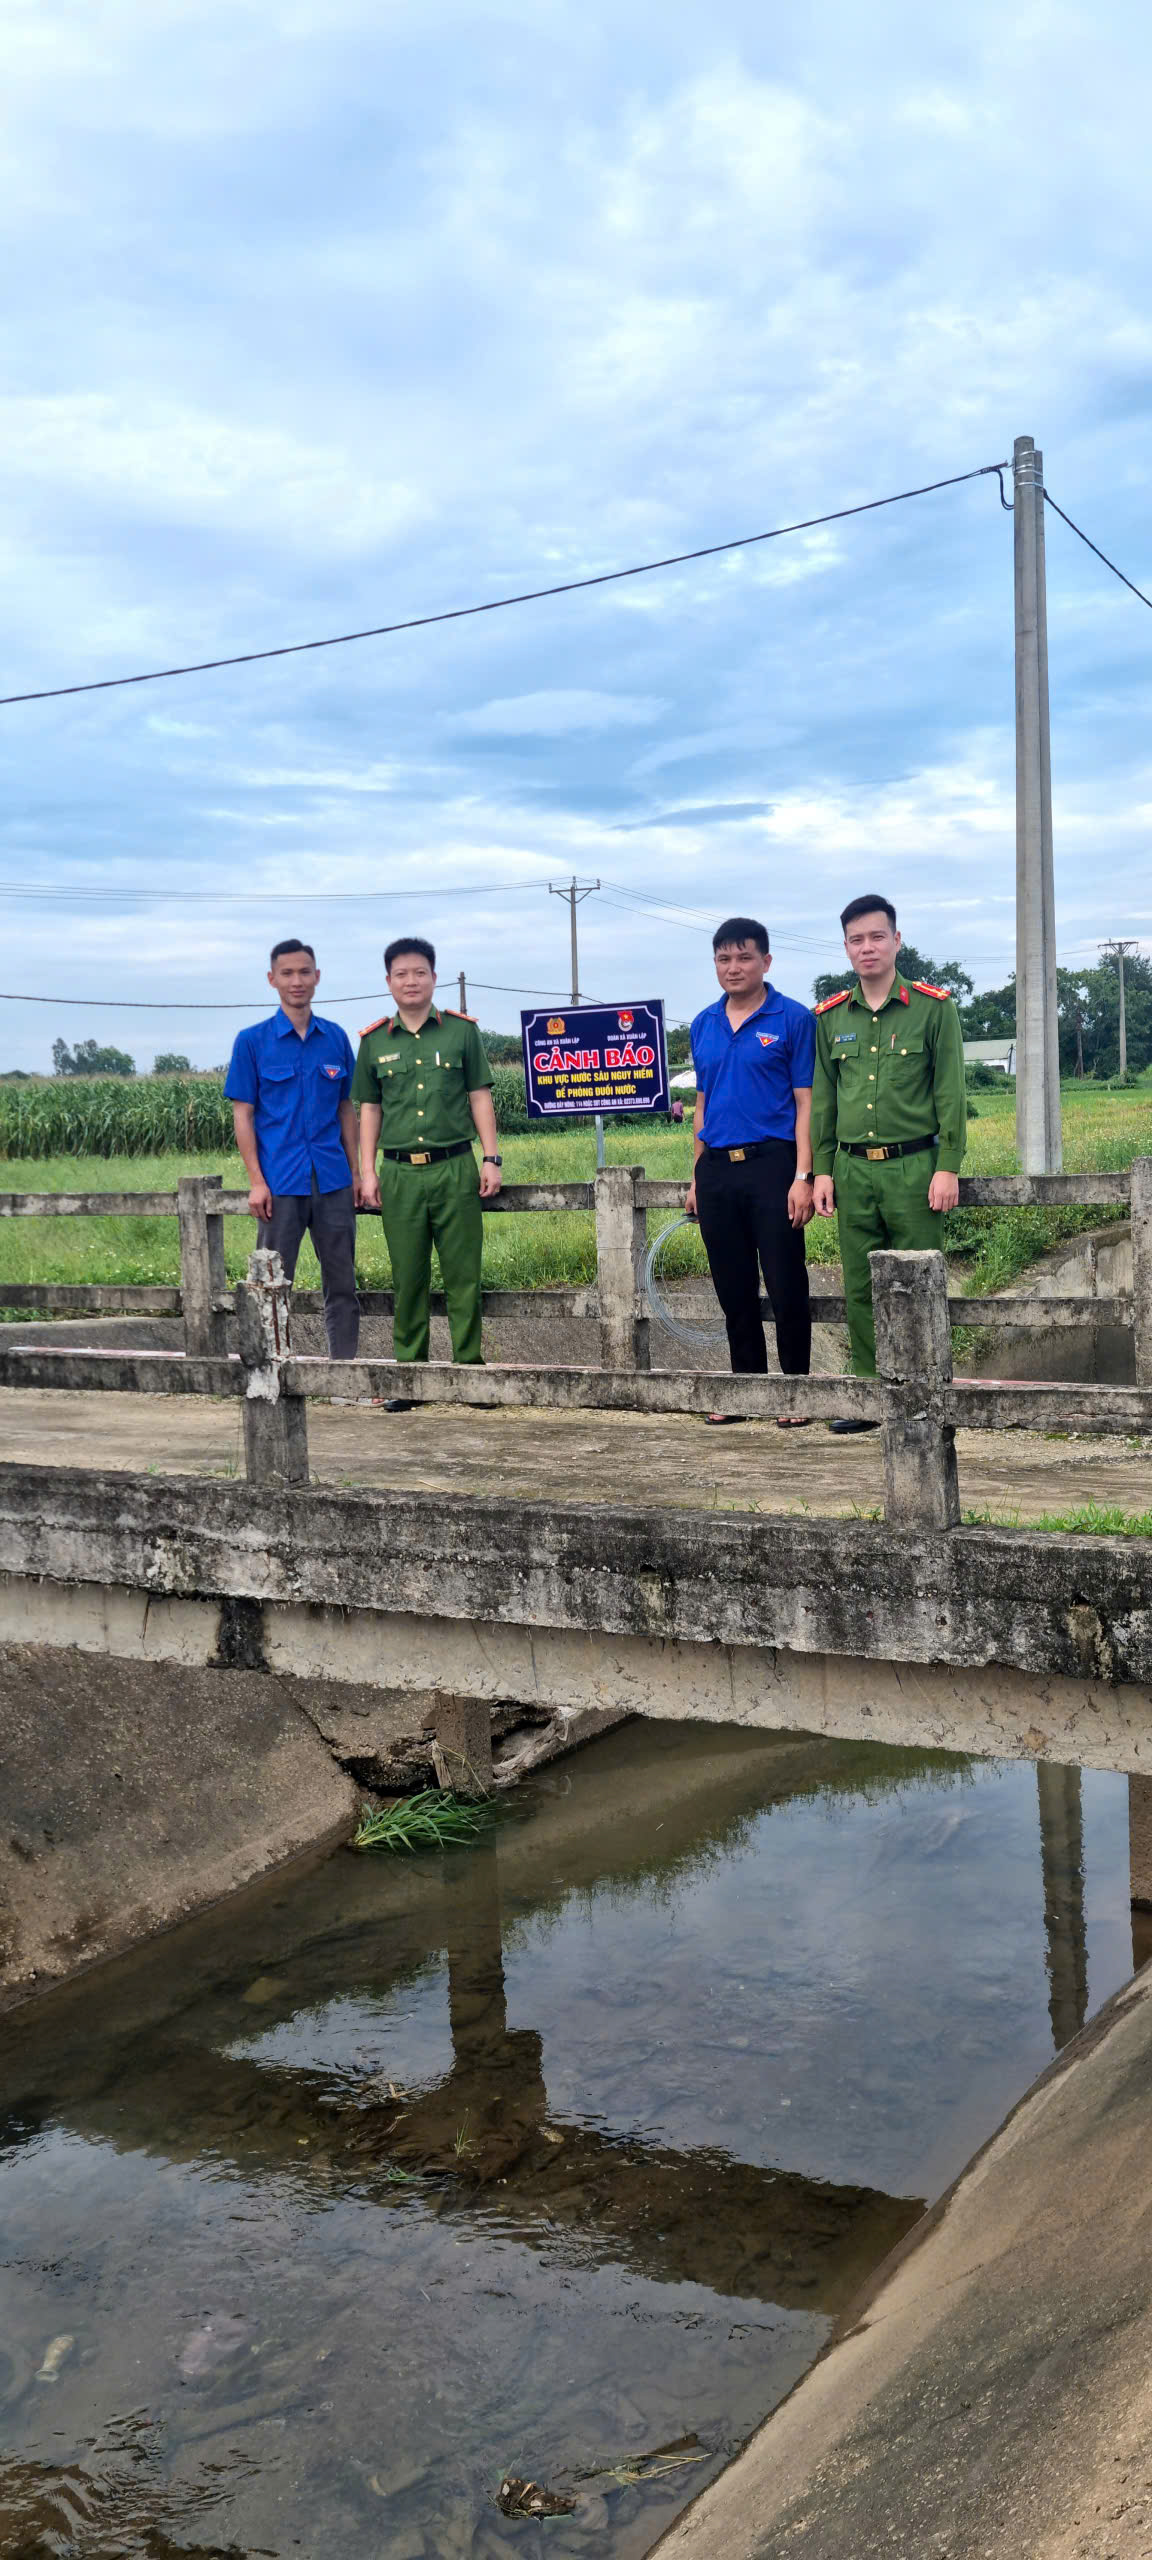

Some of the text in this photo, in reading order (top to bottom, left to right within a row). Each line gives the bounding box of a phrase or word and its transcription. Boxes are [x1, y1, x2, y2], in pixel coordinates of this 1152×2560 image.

[534, 1042, 655, 1072] CẢNH BÁO
[537, 1075, 553, 1085] KHU
[554, 1073, 569, 1086] VỰC
[571, 1071, 592, 1083] NƯỚC
[610, 1070, 632, 1081] NGUY
[633, 1066, 654, 1080] HIỂM
[567, 1086, 594, 1098] PHÒNG
[595, 1083, 613, 1096] ĐUỐI
[615, 1083, 637, 1095] NƯỚC
